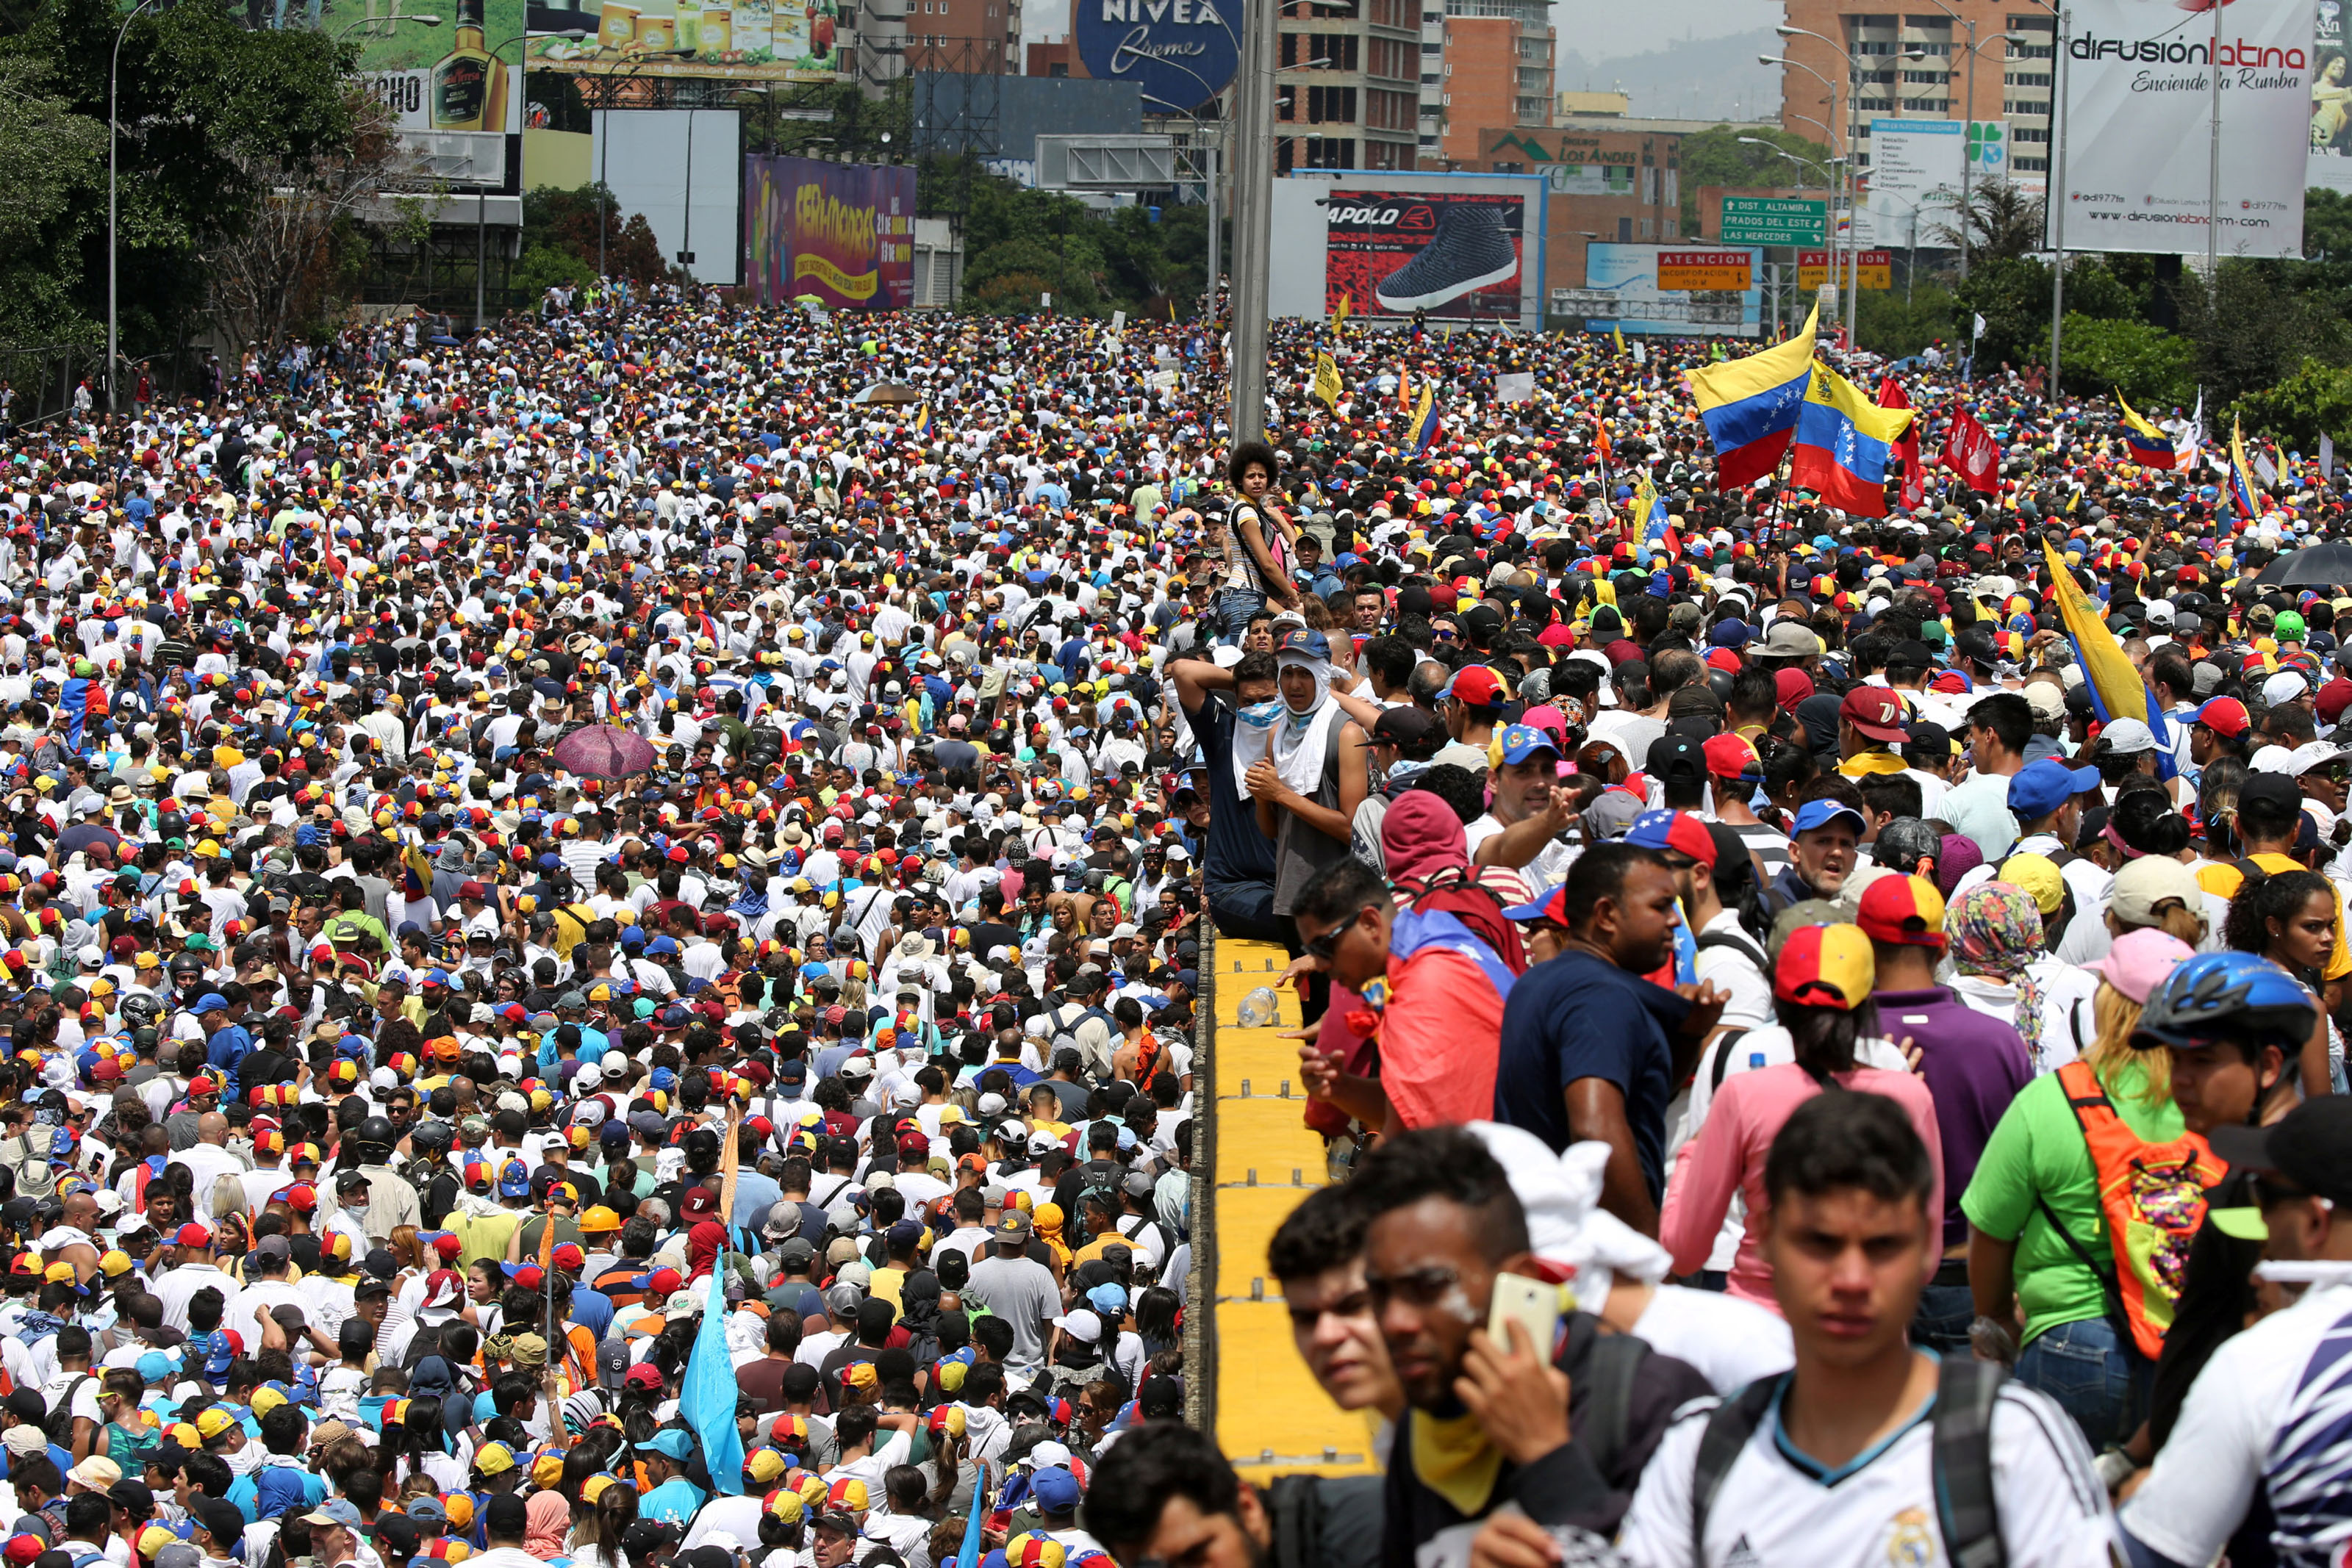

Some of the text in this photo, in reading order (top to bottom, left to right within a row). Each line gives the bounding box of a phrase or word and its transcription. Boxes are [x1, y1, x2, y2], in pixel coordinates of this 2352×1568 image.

[1102, 0, 1222, 24] NIVEA
[1111, 24, 1206, 73] Creme
[2132, 70, 2209, 93] Enciende
[2237, 68, 2302, 90] Rumba
[1559, 147, 1637, 163] LOS ANDES
[1738, 202, 1811, 212] DIST. ALTAMIRA
[1328, 206, 1399, 226] APOLO
[1724, 216, 1811, 227] PRADOS DEL ESTE
[1724, 231, 1792, 241] LAS MERCEDES
[1663, 255, 1746, 265] ATENCION
